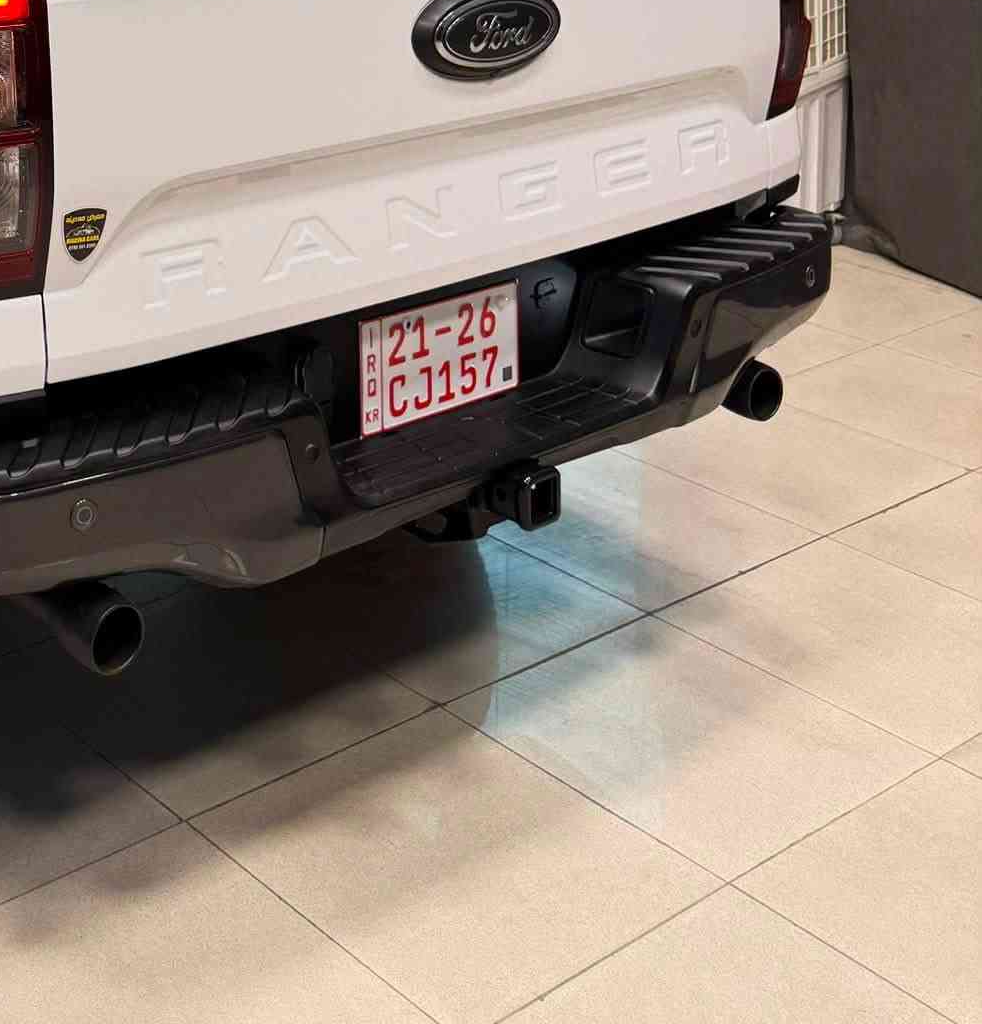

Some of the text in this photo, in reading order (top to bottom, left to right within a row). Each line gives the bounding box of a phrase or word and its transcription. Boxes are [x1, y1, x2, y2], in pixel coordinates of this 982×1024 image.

[469, 8, 535, 53] Ford
[139, 117, 732, 312] RANGER
[388, 297, 497, 367] 21-26
[388, 345, 499, 418] CJ157
[364, 409, 380, 425] KR
